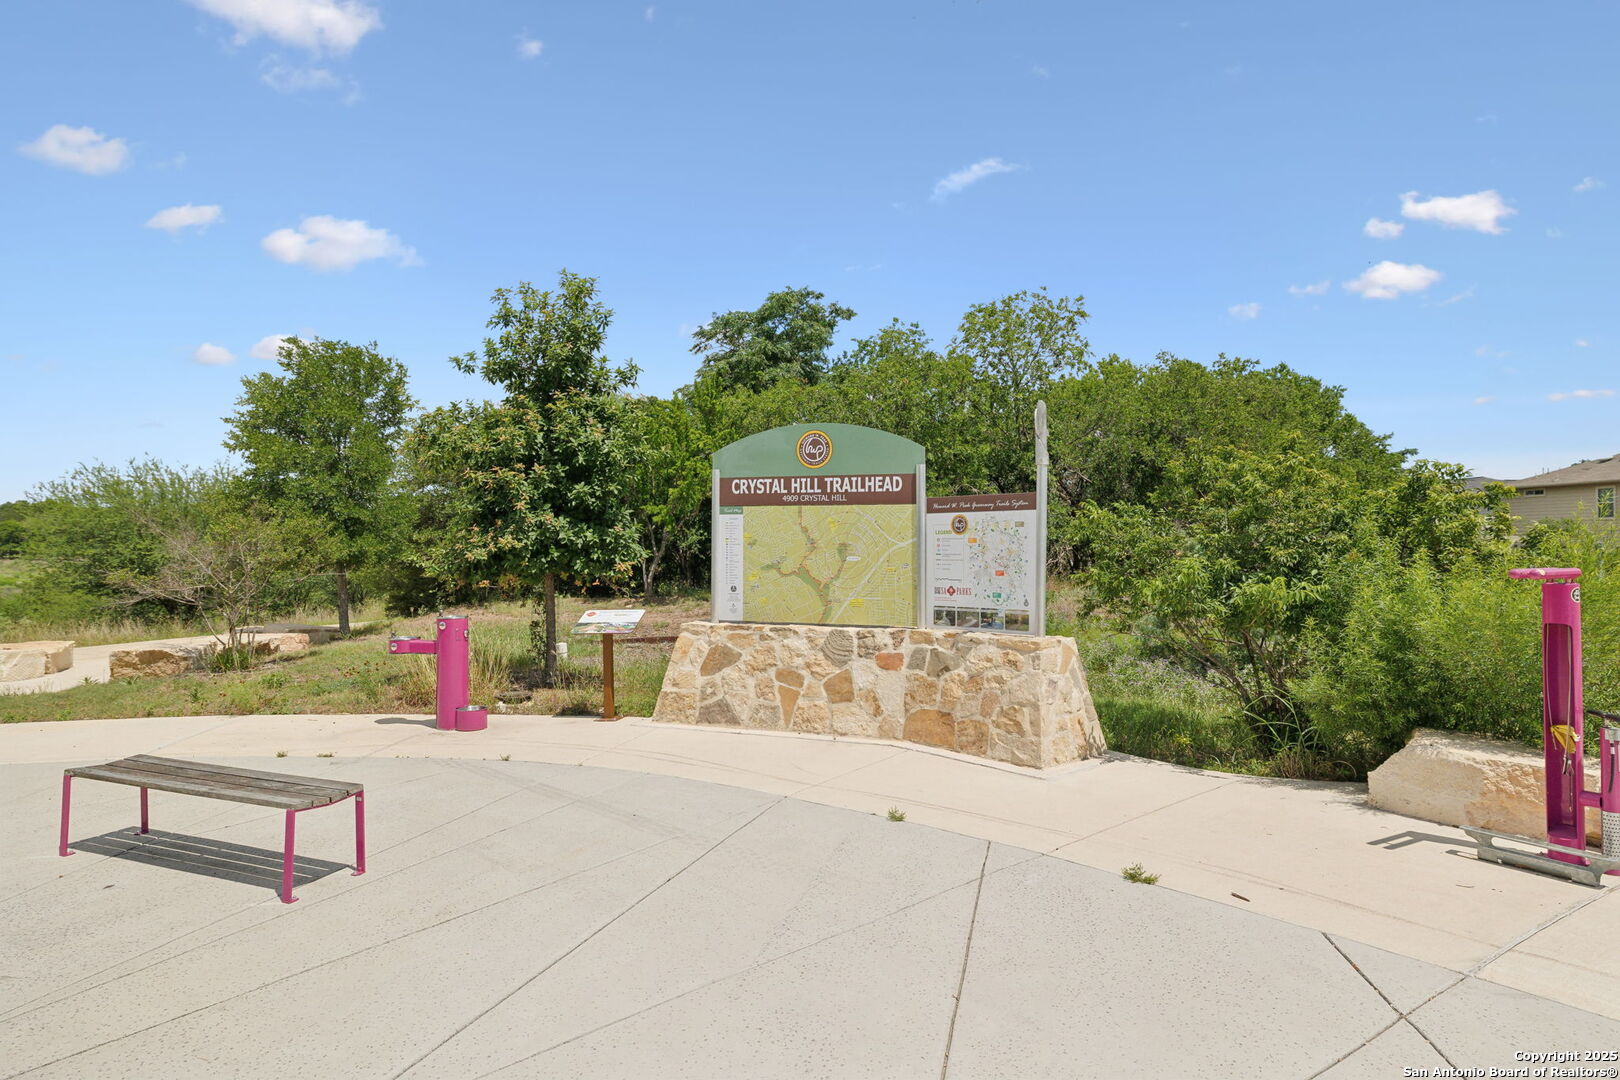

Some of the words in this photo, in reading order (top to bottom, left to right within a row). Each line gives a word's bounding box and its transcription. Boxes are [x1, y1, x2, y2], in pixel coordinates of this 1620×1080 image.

[731, 478, 788, 495] CRYSTAL
[791, 477, 822, 493] HILL
[824, 475, 903, 493] TRAILHEAD
[782, 494, 799, 502] 4909
[800, 494, 830, 502] CRYSTAL
[831, 494, 847, 502] HILL
